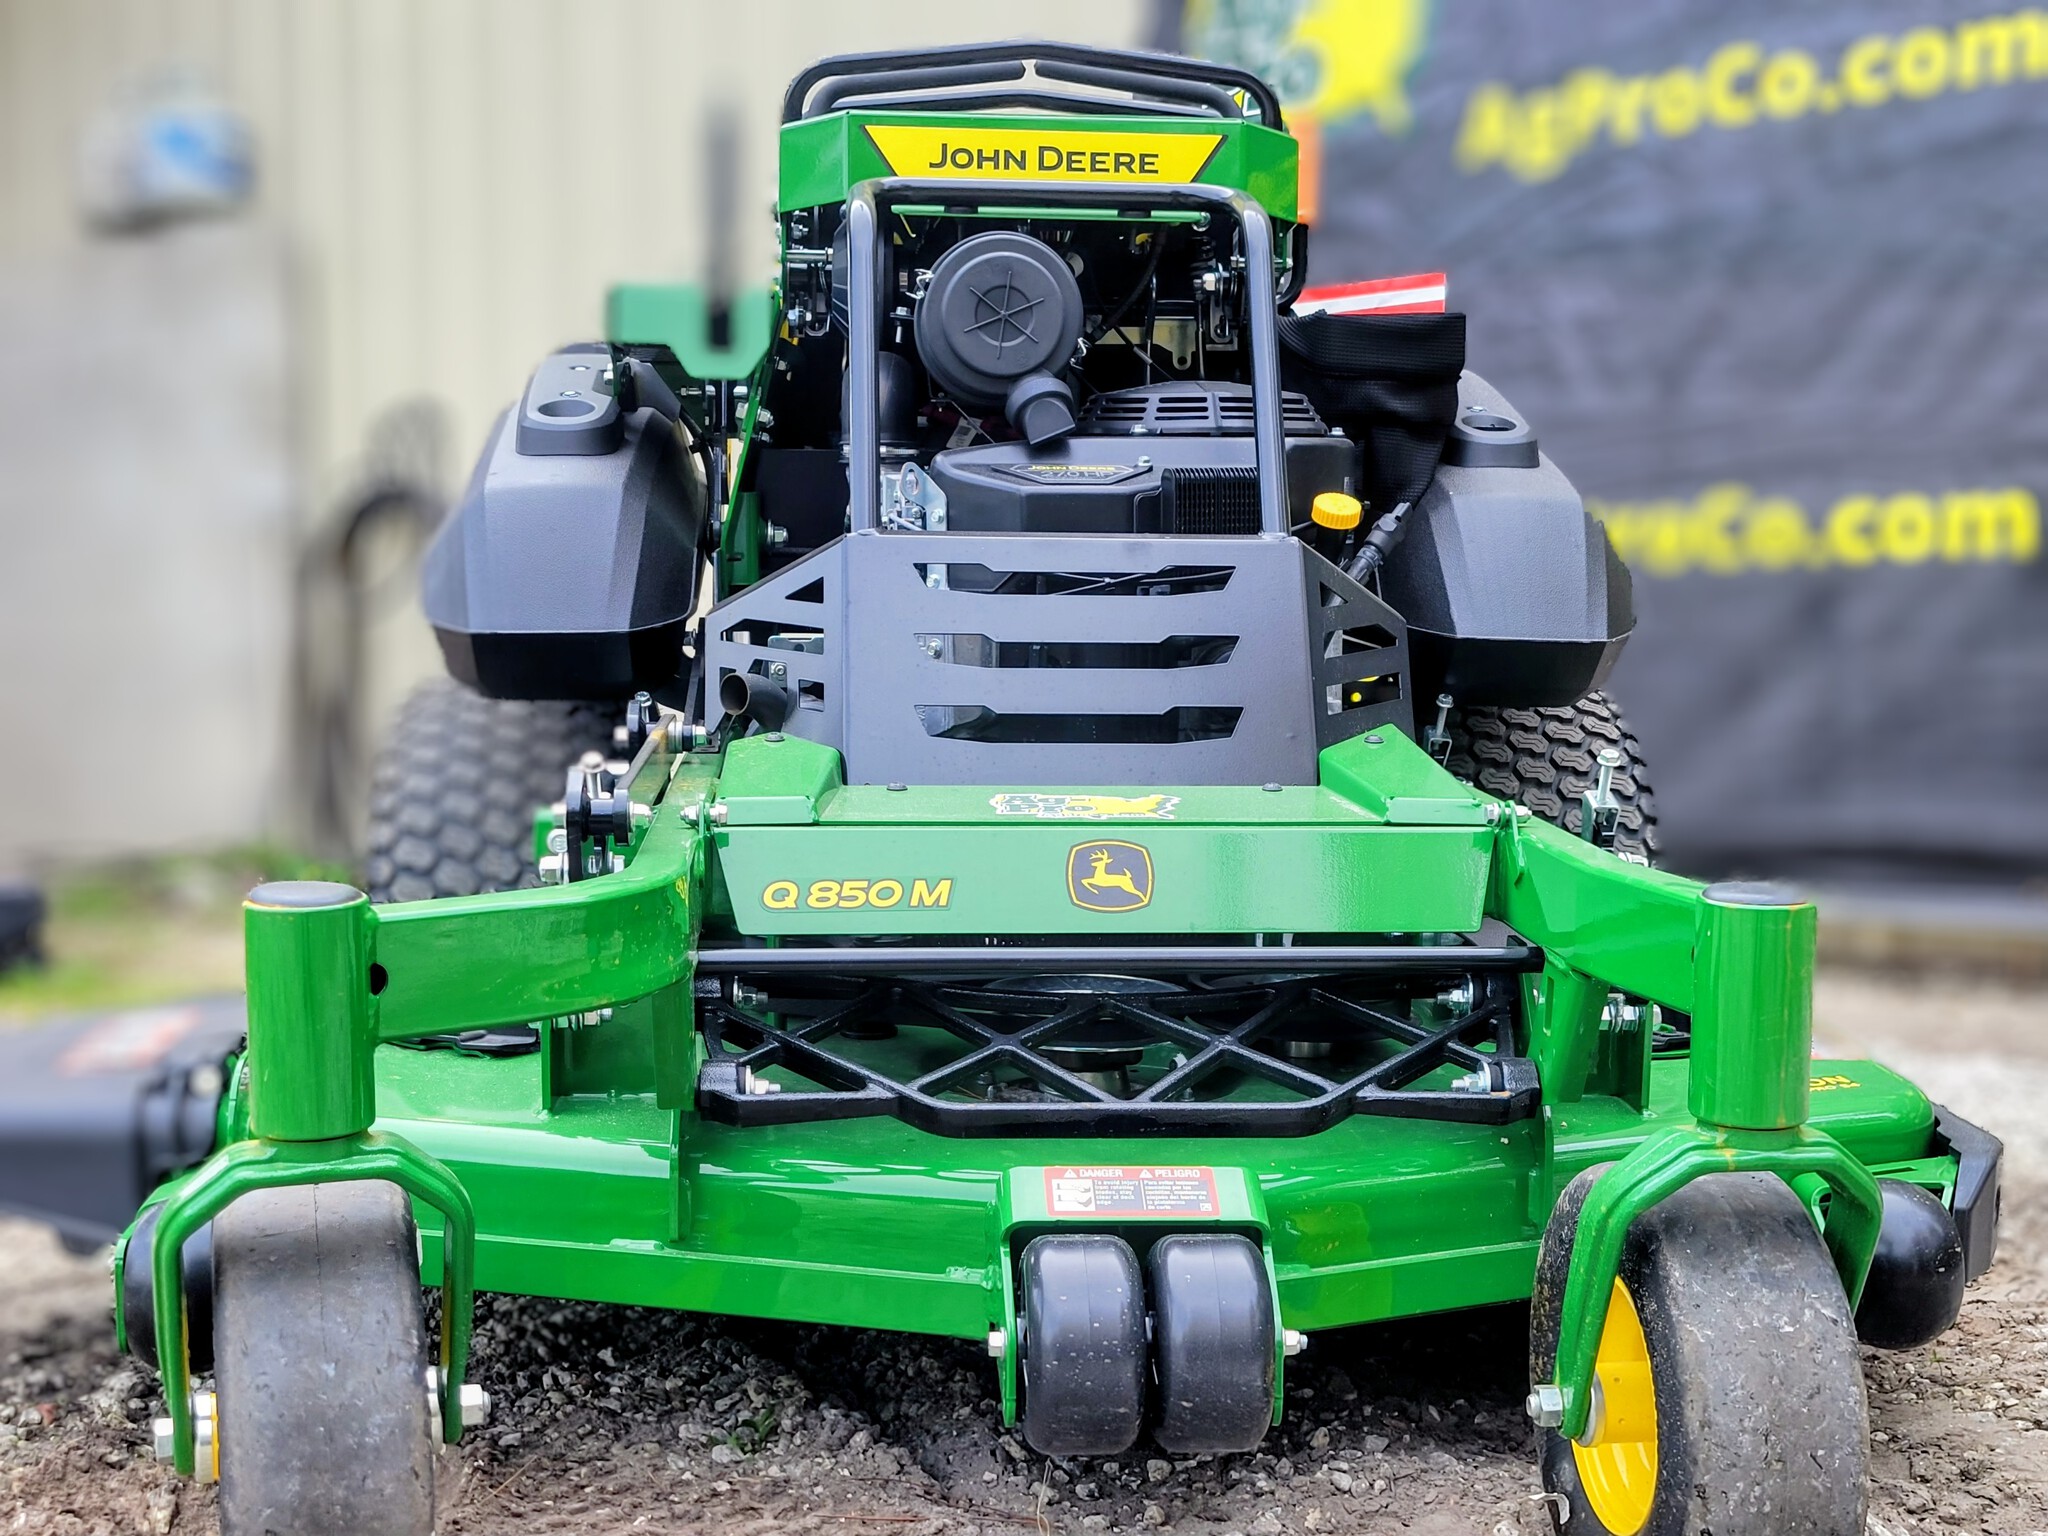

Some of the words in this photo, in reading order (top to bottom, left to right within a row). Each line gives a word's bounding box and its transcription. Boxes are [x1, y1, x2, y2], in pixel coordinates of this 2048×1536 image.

[929, 143, 1027, 170] JOHN
[1038, 146, 1159, 174] DEERE
[763, 880, 799, 909] Q
[807, 879, 904, 908] 850
[908, 878, 953, 907] M
[1079, 1168, 1124, 1177] DANGER
[1154, 1169, 1200, 1178] PELIGRO
